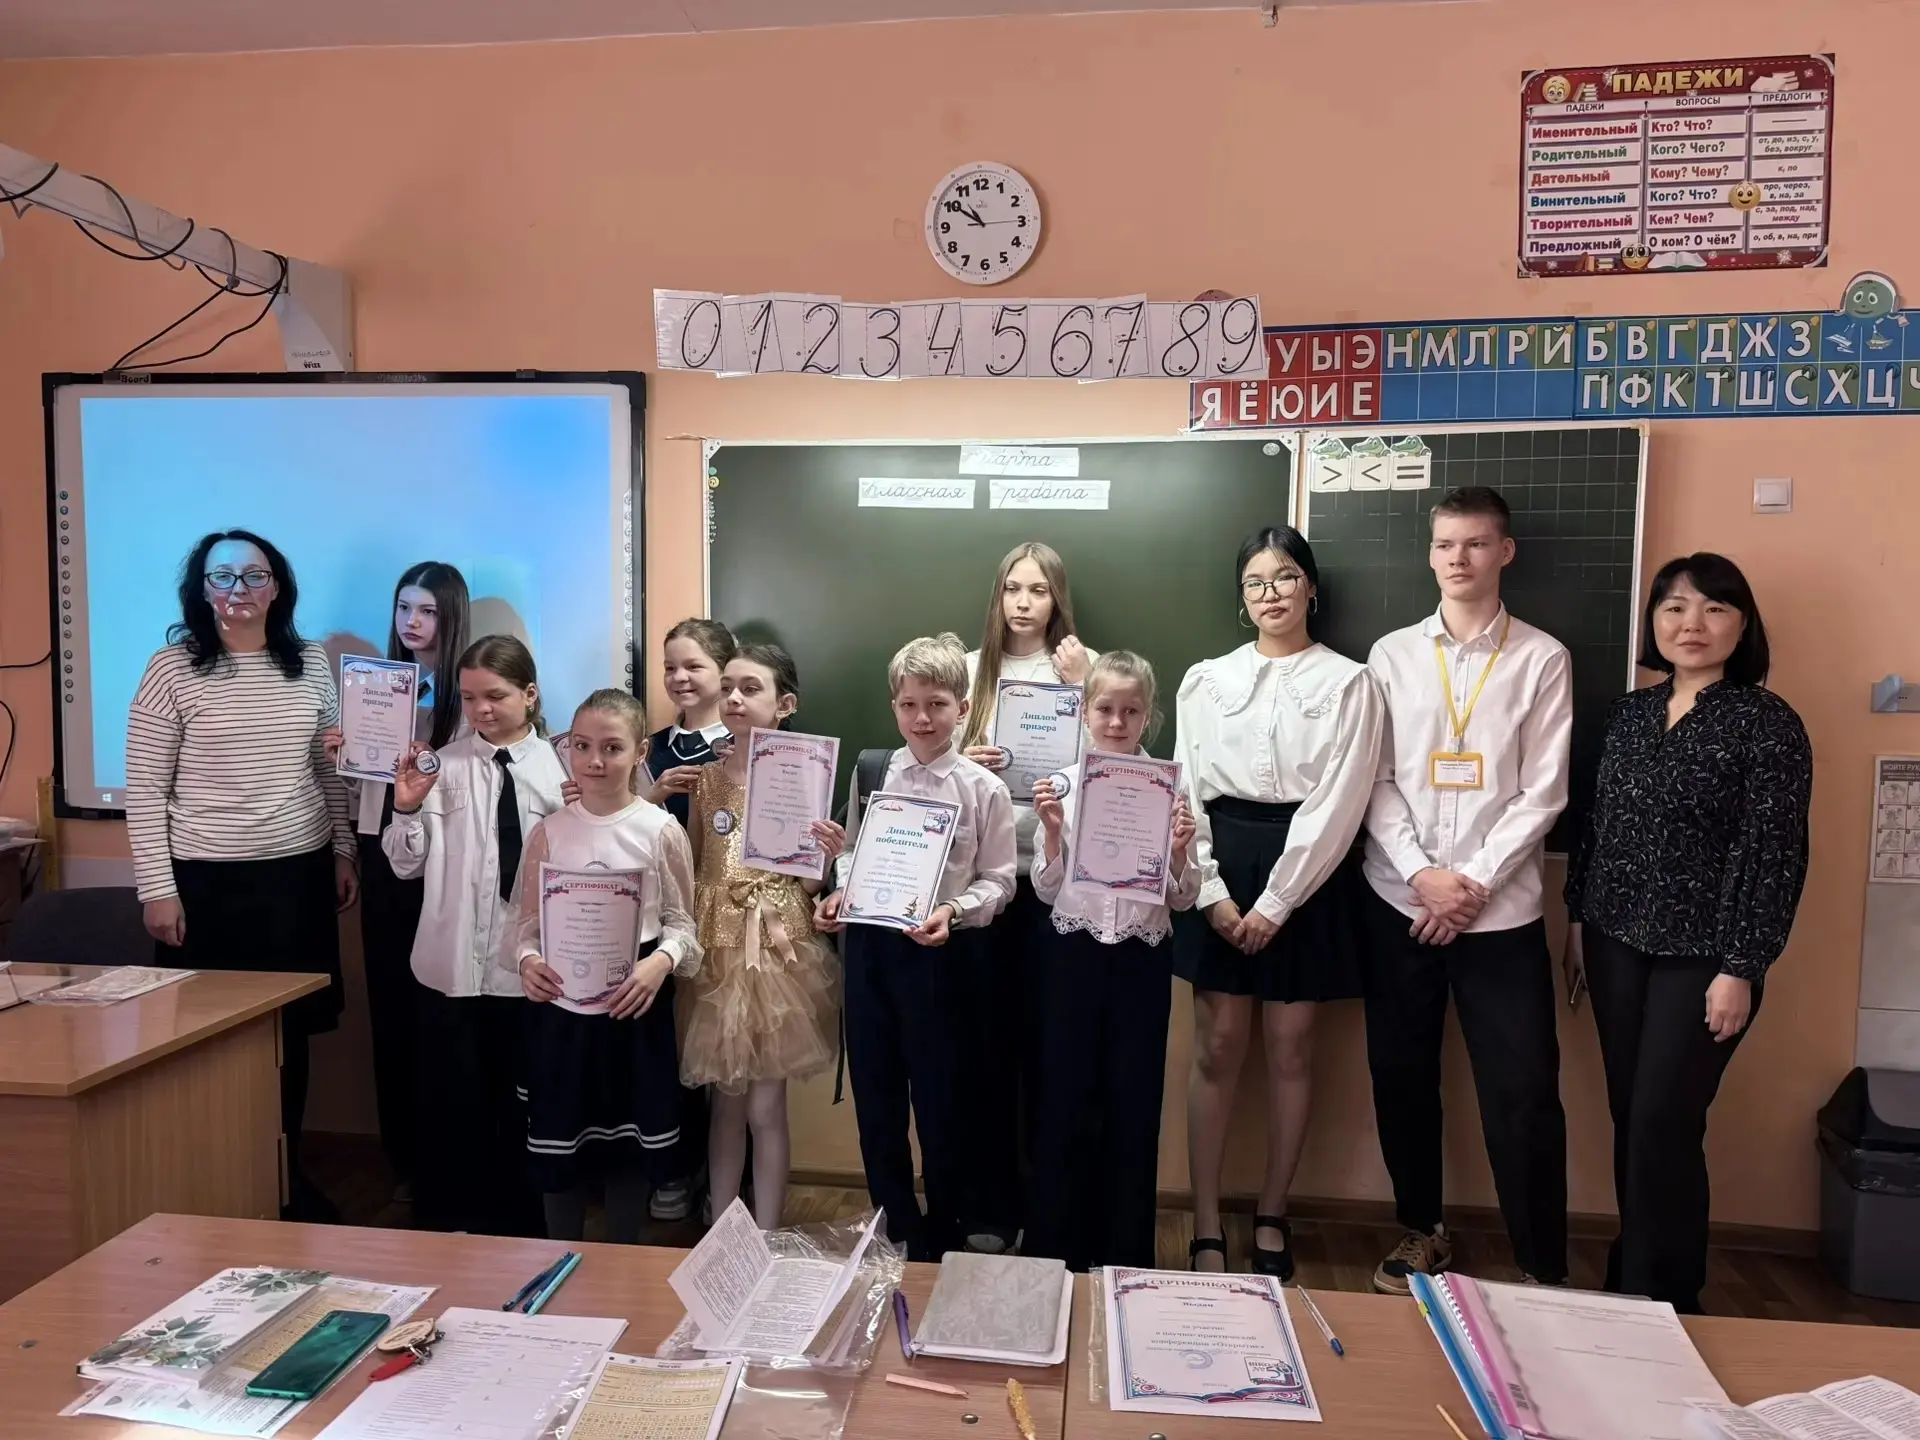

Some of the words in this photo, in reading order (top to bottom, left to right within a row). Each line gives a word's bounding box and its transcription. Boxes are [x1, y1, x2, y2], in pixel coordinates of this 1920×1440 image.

[1611, 67, 1744, 95] ПАДЕЖИ
[1675, 96, 1721, 107] ВОПРОСЫ
[1762, 92, 1812, 102] ПРЕДЛОГИ
[1565, 103, 1605, 113] ПАДЕЖИ
[1532, 122, 1638, 139] Именительный
[1651, 120, 1680, 133] Кто?
[1684, 119, 1713, 132] Что?
[1531, 145, 1627, 162] Родительный
[1650, 142, 1686, 155] Кого?
[1690, 140, 1725, 153] Чего?
[1531, 169, 1611, 187] Дательный
[1650, 166, 1687, 180] Кому?
[1691, 164, 1729, 178] Чему?
[955, 184, 970, 198] 11
[972, 177, 990, 191] 12
[996, 181, 1005, 194] 1
[1010, 195, 1020, 208] 2
[1530, 192, 1626, 207] Винительный
[1650, 189, 1685, 202] Кого?
[1688, 188, 1718, 200] Что?
[944, 200, 961, 213] 10
[1017, 214, 1026, 228] 3
[1530, 215, 1633, 231] Творительный
[1649, 213, 1680, 226] Кем?
[1683, 212, 1714, 224] Чем?
[940, 221, 951, 234] 9
[947, 241, 958, 253] 8
[1011, 235, 1022, 248] 4
[1529, 238, 1622, 254] Предложный
[1649, 236, 1657, 248] О
[1661, 235, 1690, 248] ком?
[1694, 234, 1703, 246] О
[1706, 233, 1737, 246] чём?
[960, 254, 970, 267] 7
[979, 258, 991, 271] 6
[999, 251, 1008, 264] 5
[682, 300, 722, 368] 0
[750, 300, 772, 373] 1
[801, 303, 839, 373] 2
[860, 308, 901, 378] 3
[928, 304, 962, 375] 4
[986, 304, 1028, 376] 5
[1050, 305, 1094, 377] 6
[1103, 301, 1145, 378] 7
[1161, 303, 1210, 378] 8
[1216, 297, 1258, 374] 9
[1586, 326, 1608, 362] Б
[1627, 325, 1649, 361] В
[1668, 324, 1689, 359] Г
[1700, 322, 1733, 363] Д
[1739, 321, 1776, 358] Ж
[1786, 320, 1811, 357] З
[1275, 337, 1302, 373] У
[1311, 336, 1341, 371] Ы
[1351, 334, 1376, 370] Э
[1386, 333, 1413, 369] Н
[1421, 332, 1456, 368] М
[1463, 330, 1490, 367] Л
[1507, 330, 1530, 365] Р
[1543, 324, 1572, 364] Й
[1582, 374, 1608, 409] П
[1618, 373, 1652, 409] Ф
[1662, 372, 1689, 408] К
[1705, 371, 1731, 407] Т
[1739, 370, 1775, 406] Ш
[1784, 369, 1809, 406] С
[1822, 368, 1852, 405] Х
[1866, 368, 1896, 408] Ц
[1200, 387, 1222, 422] Я
[1239, 381, 1259, 421] Ё
[1271, 384, 1304, 421] Ю
[1310, 383, 1338, 418] И
[1352, 381, 1373, 416] Е
[362, 687, 394, 698] Диплом
[362, 698, 394, 708] призера
[1020, 711, 1058, 722] Диплом
[1020, 722, 1057, 733] призера
[770, 743, 813, 755] СЕРТИФИКАТ
[1105, 766, 1154, 779] СЕРТИФИКАТ
[885, 825, 924, 838] Диплом
[875, 836, 929, 850] победителя
[564, 881, 620, 891] СЕРТИФИКАТ
[1150, 1279, 1235, 1289] СЕРТИФИКАТ
